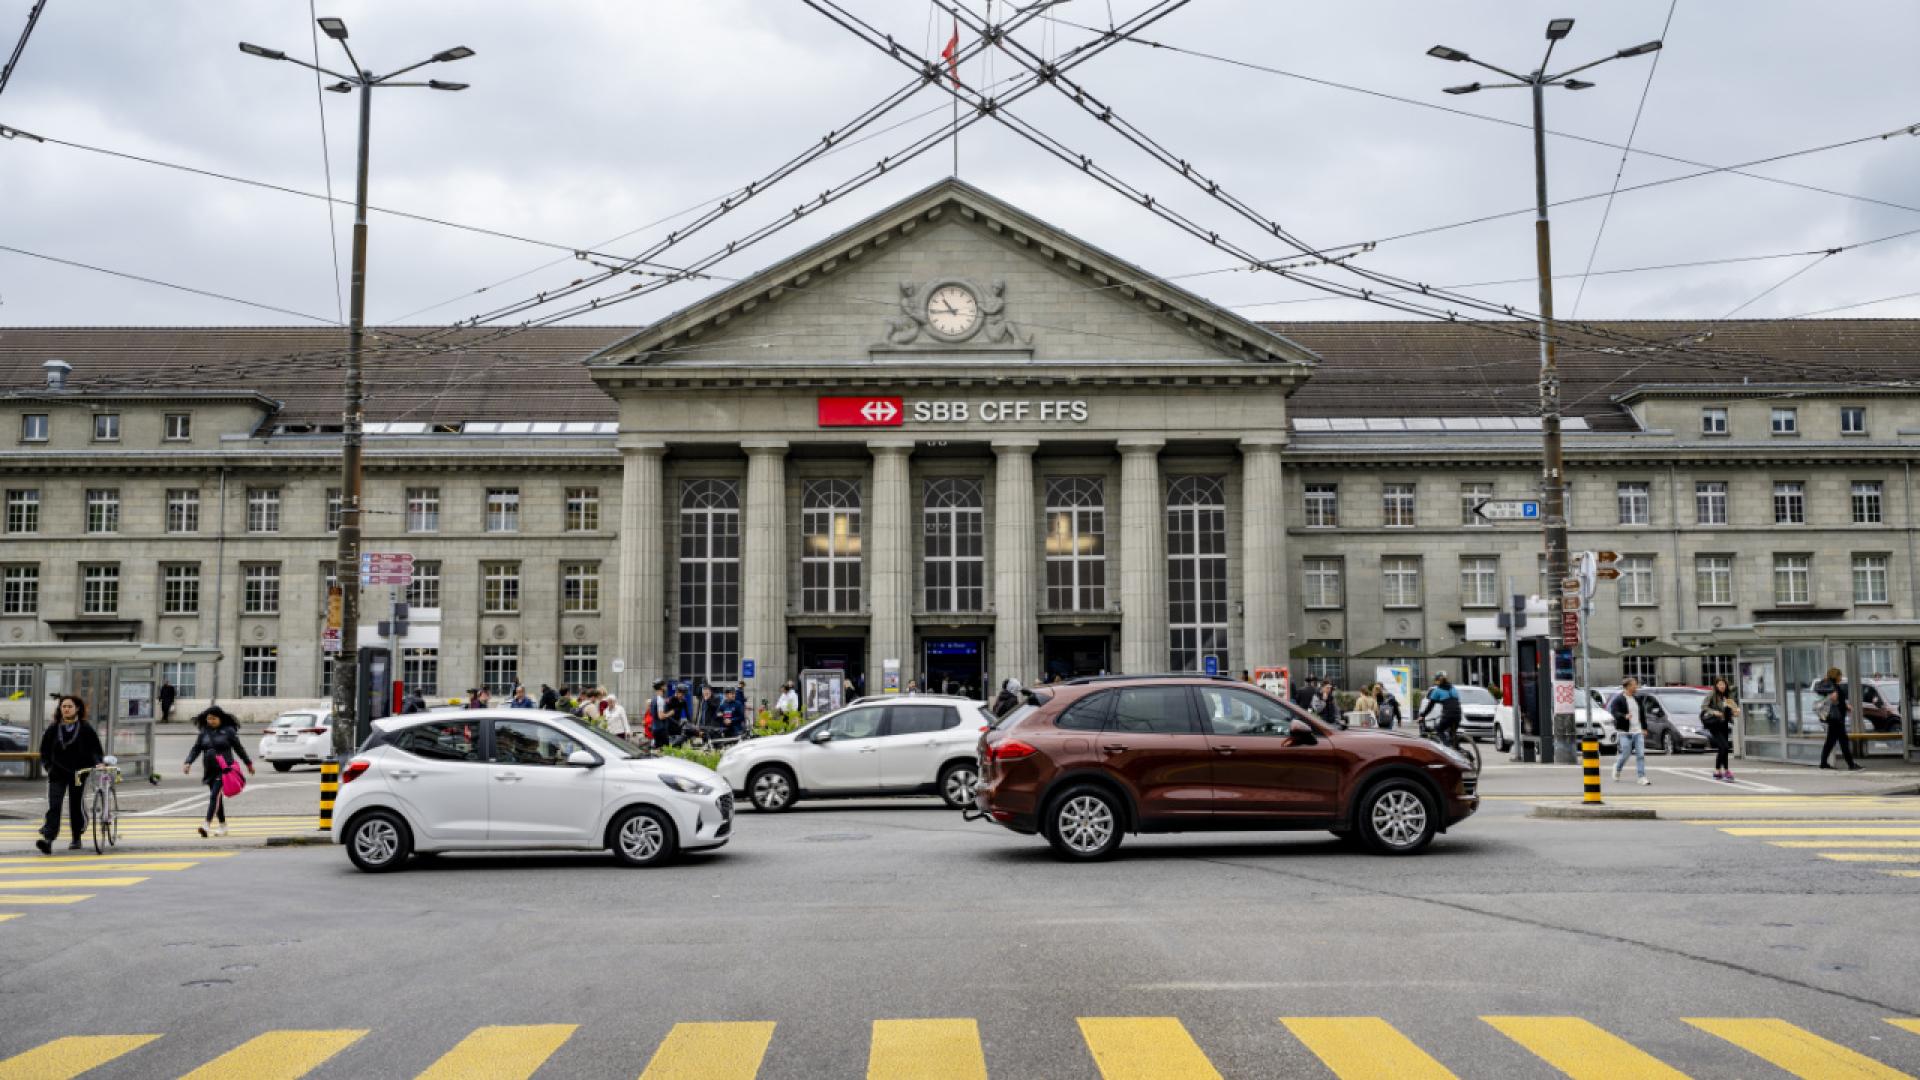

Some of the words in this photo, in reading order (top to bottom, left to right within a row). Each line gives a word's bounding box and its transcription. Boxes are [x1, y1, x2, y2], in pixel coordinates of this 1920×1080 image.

[914, 401, 969, 421] SBB
[979, 401, 1030, 421] CFF
[1040, 401, 1088, 421] FFS
